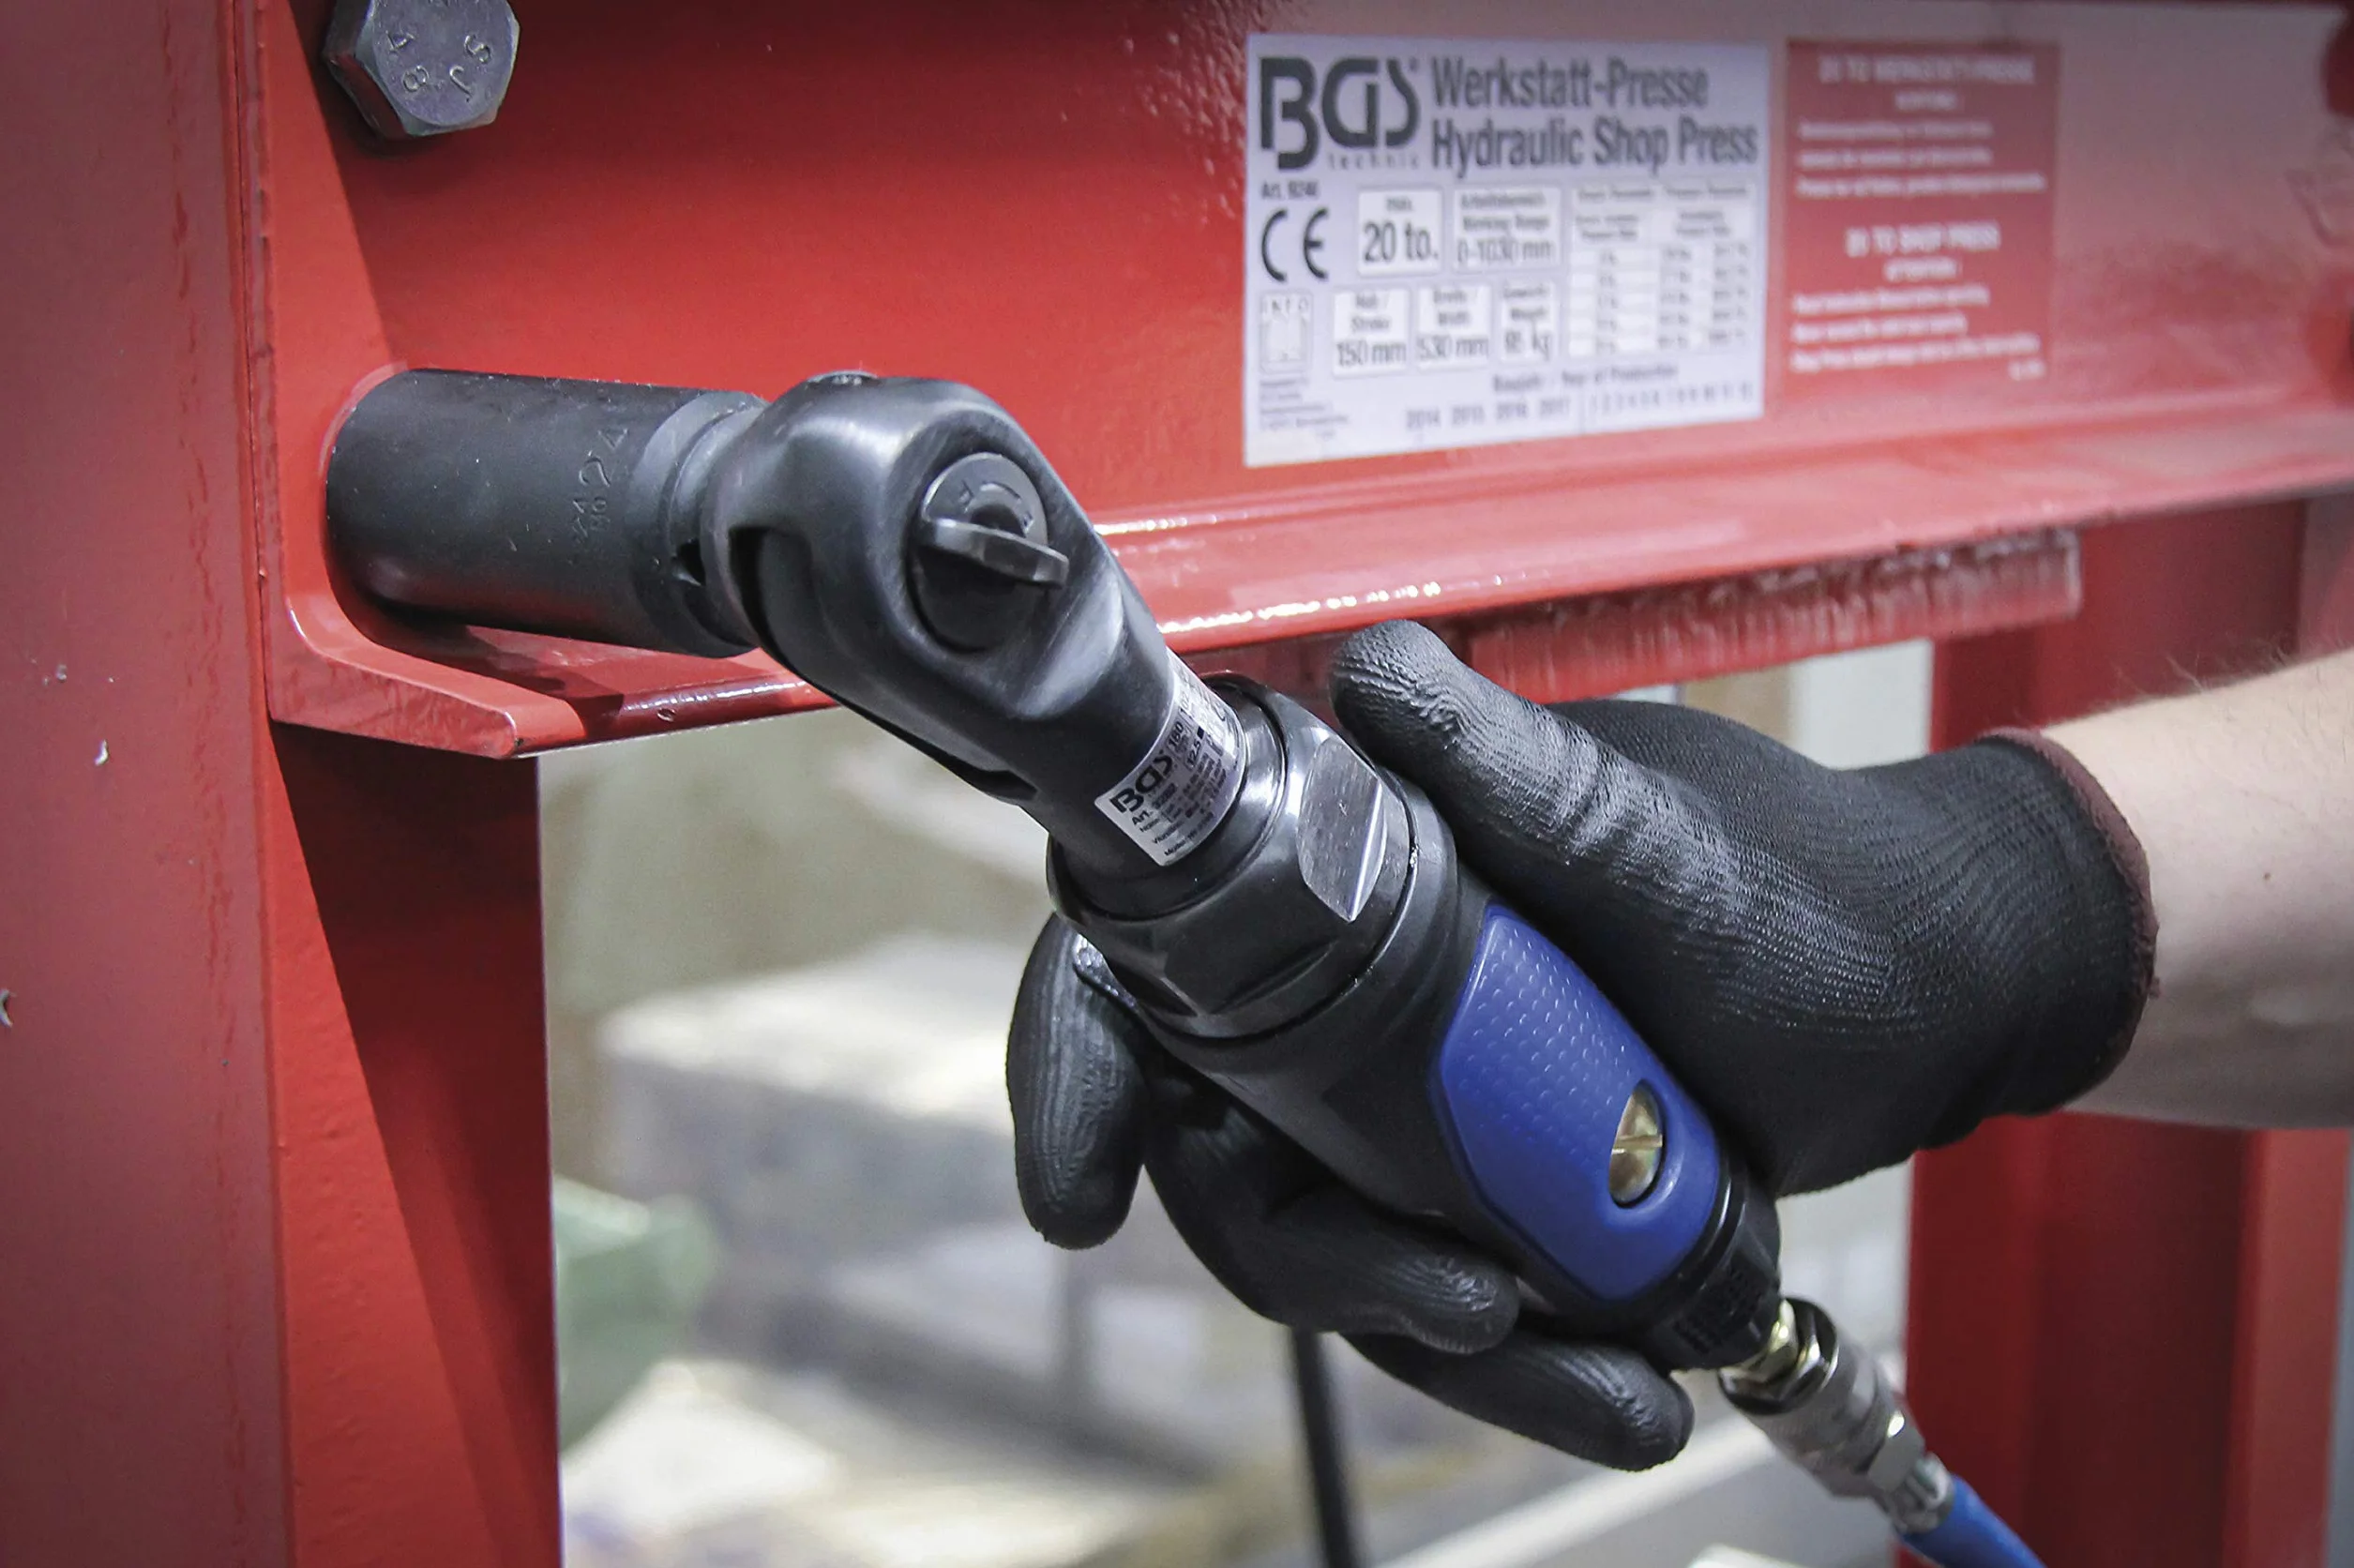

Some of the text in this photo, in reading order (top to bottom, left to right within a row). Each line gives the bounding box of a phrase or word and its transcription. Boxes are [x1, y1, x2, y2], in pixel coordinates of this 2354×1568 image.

[1431, 56, 1709, 108] Werkstatt-Presse
[1260, 56, 1421, 171] BGS
[1431, 113, 1758, 179] Hydraulic Shop Press
[1261, 207, 1328, 281] CE
[1364, 220, 1440, 263] 20 to.
[1335, 340, 1407, 368] 150 mm
[1456, 337, 1489, 360] mm
[1109, 749, 1172, 814] BGS
